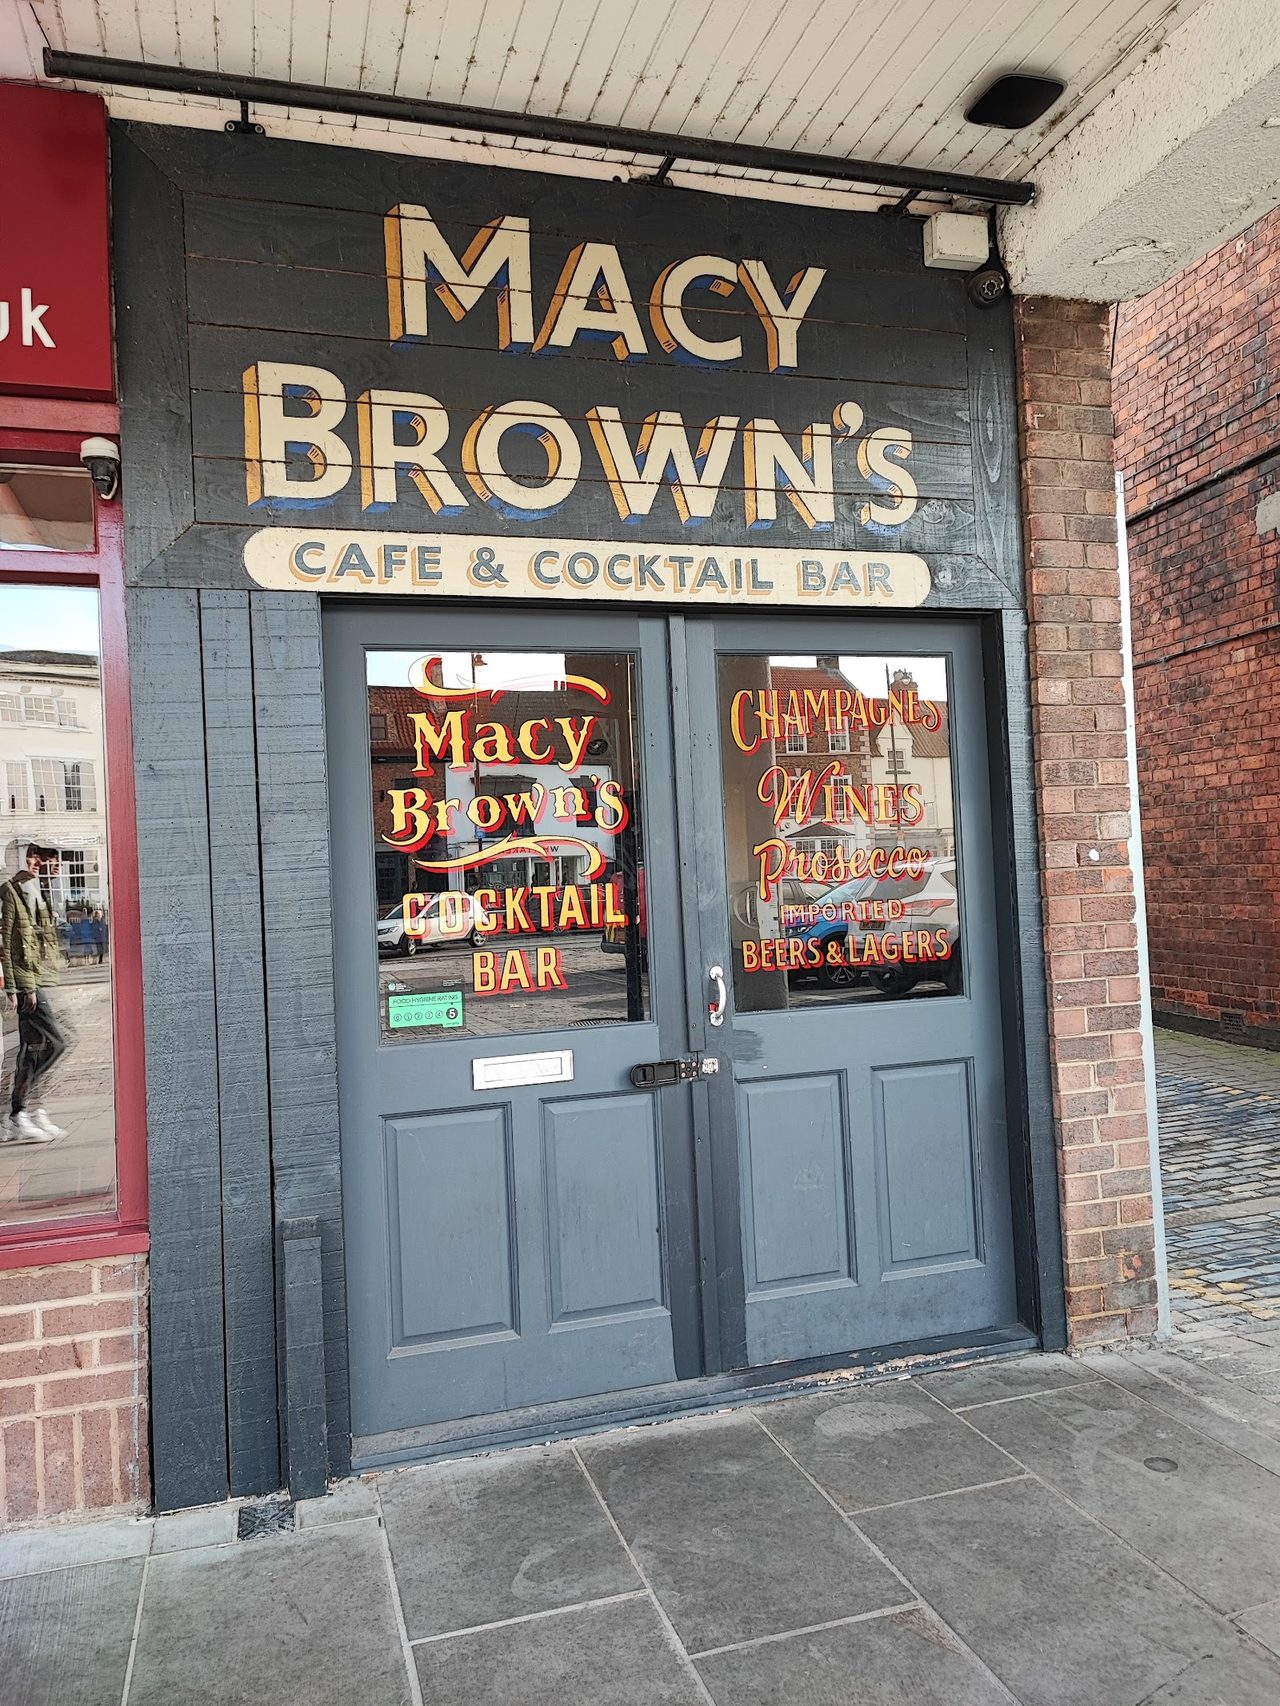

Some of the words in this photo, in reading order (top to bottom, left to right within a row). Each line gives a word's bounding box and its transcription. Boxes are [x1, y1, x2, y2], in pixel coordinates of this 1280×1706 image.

[384, 202, 827, 374] MACY
[242, 361, 917, 535] BROWN'S
[288, 541, 442, 586] CAFE
[466, 546, 510, 588] &
[527, 550, 774, 595] COCKTAIL
[797, 559, 894, 597] BAR
[407, 709, 600, 776] Macy
[730, 688, 943, 756] CHAMPAGNES
[753, 838, 930, 903] Prosecco
[403, 882, 629, 939] COCKTAIL
[780, 898, 907, 926] IMPORTED
[437, 994, 459, 1002] RATING
[473, 946, 568, 997] BAR
